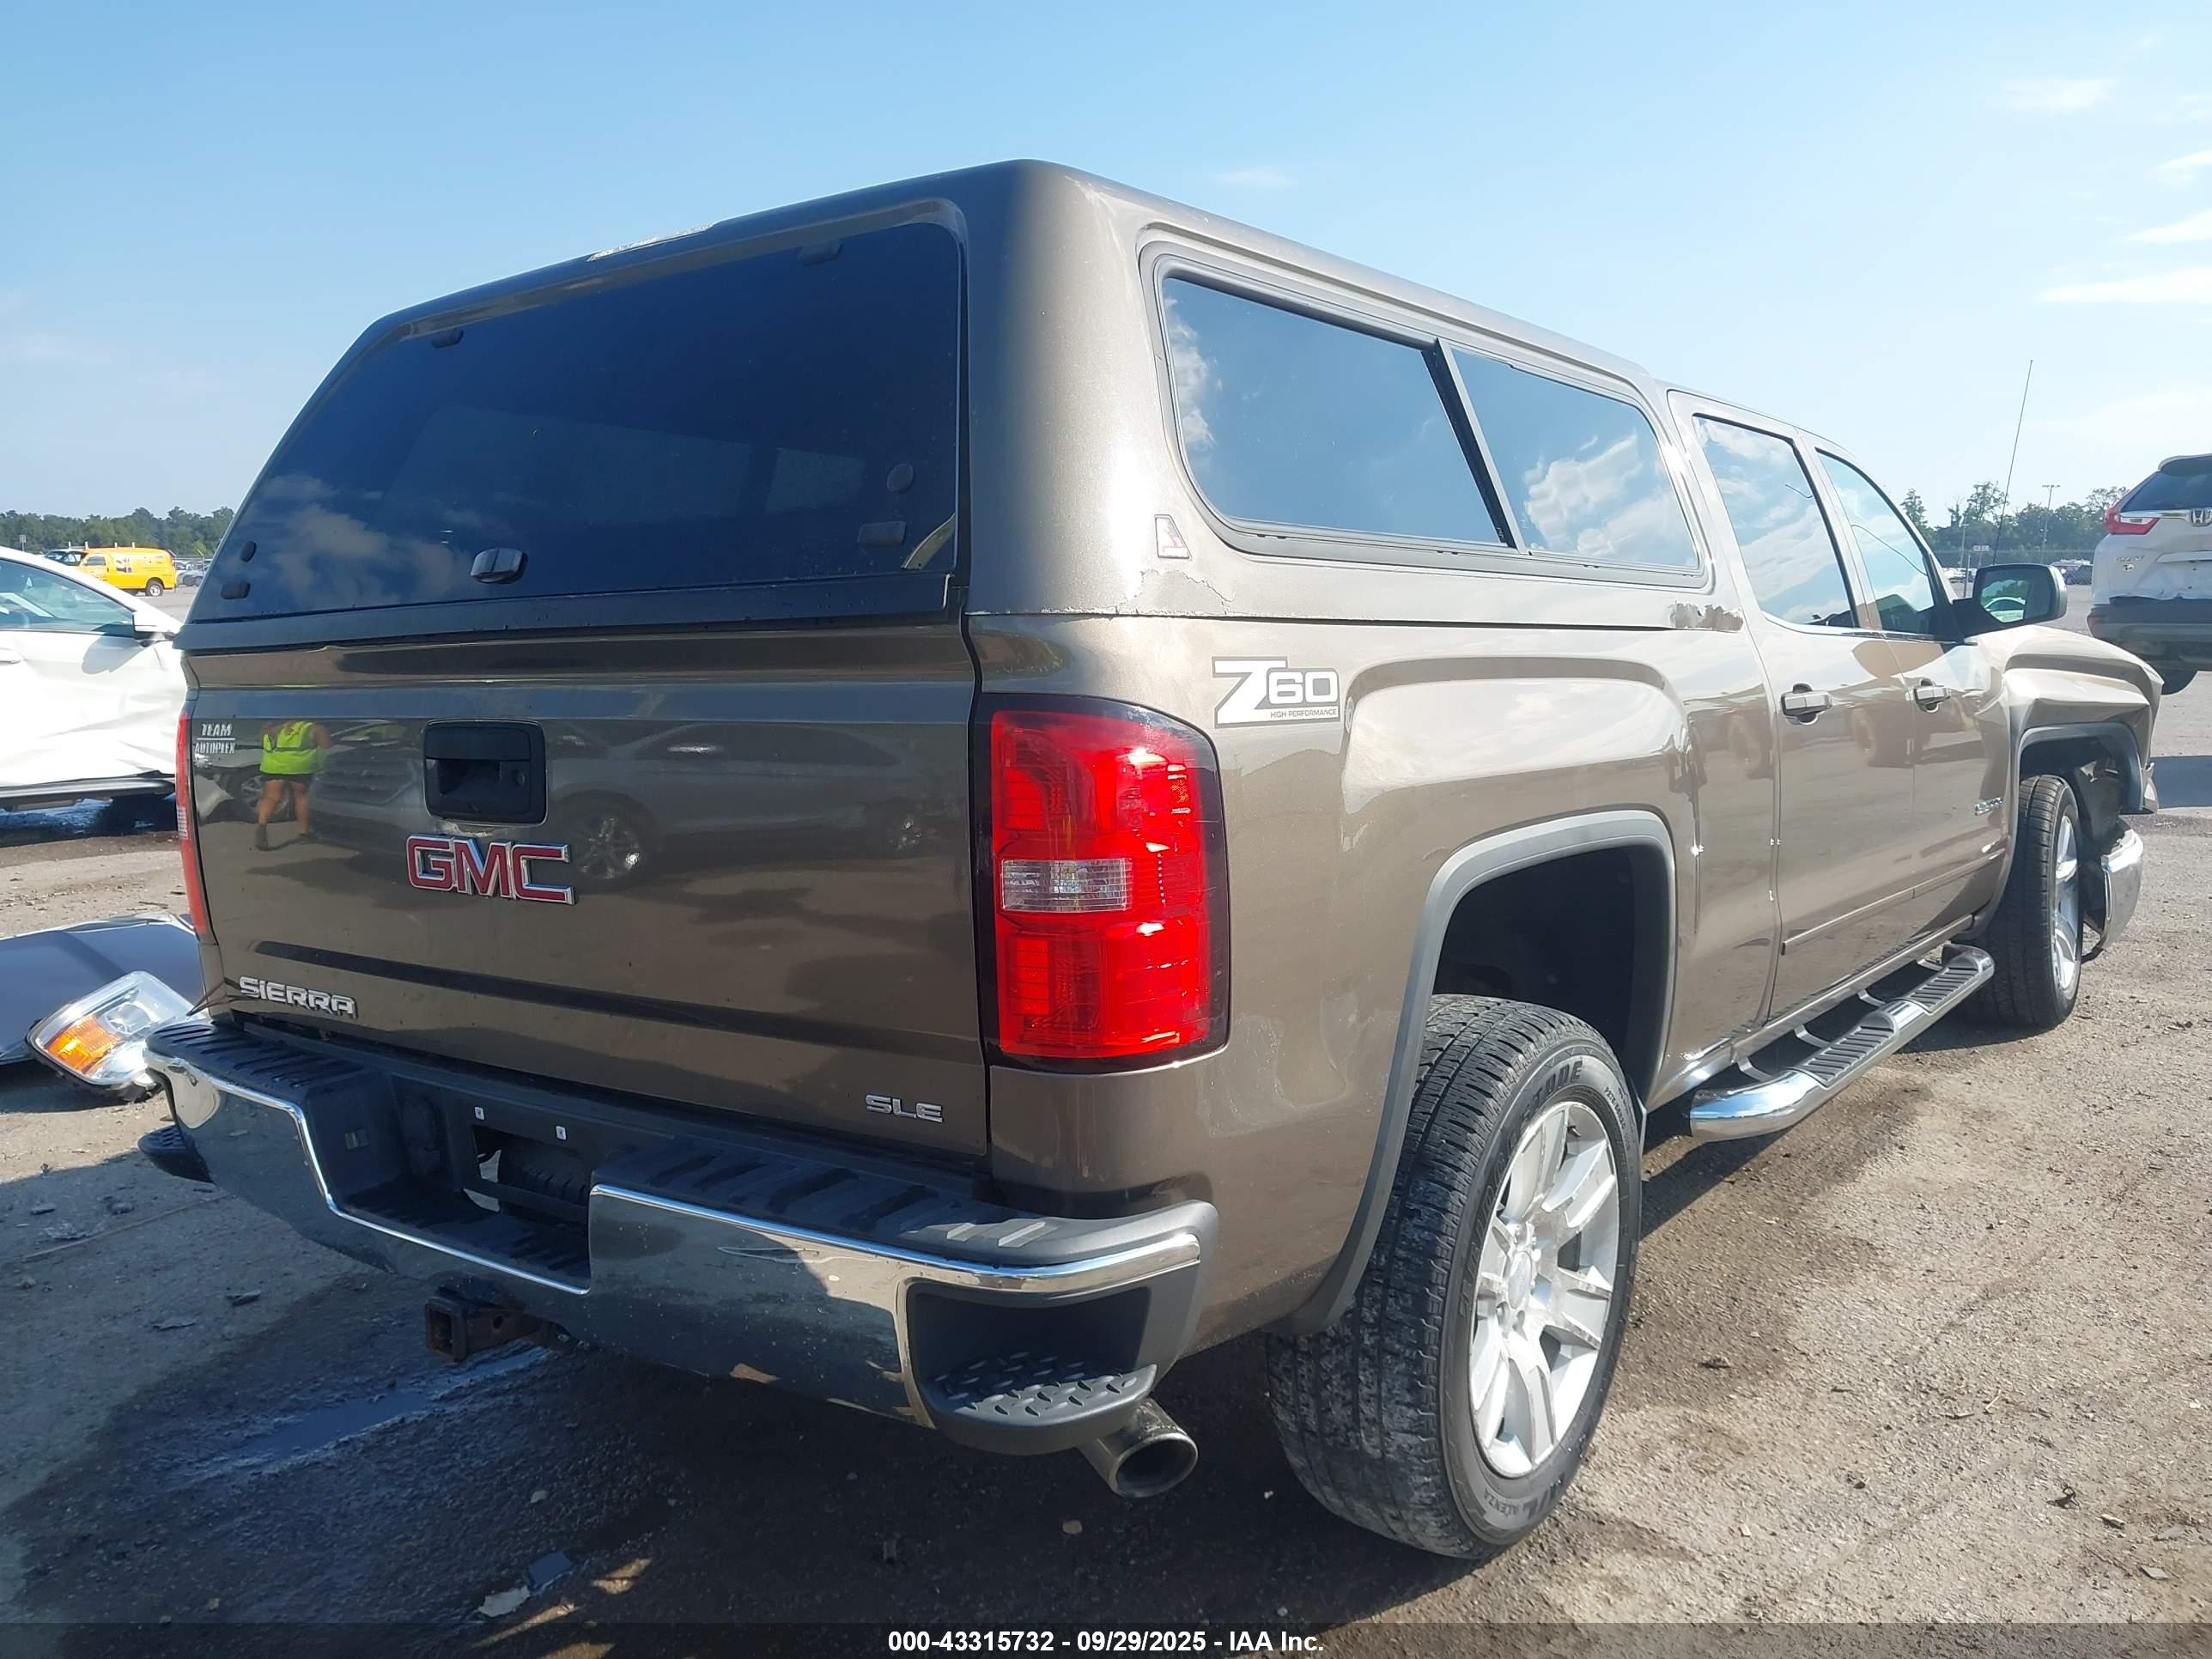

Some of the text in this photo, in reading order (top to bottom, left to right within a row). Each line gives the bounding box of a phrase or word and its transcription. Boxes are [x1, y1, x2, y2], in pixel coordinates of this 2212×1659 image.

[1288, 708, 1337, 718] PERFORMANCE
[201, 723, 233, 736] TEAM
[194, 742, 236, 754] AUTOPLEX
[406, 834, 575, 906] GMC
[239, 975, 358, 1019] SIERRA
[865, 1094, 944, 1123] SLE
